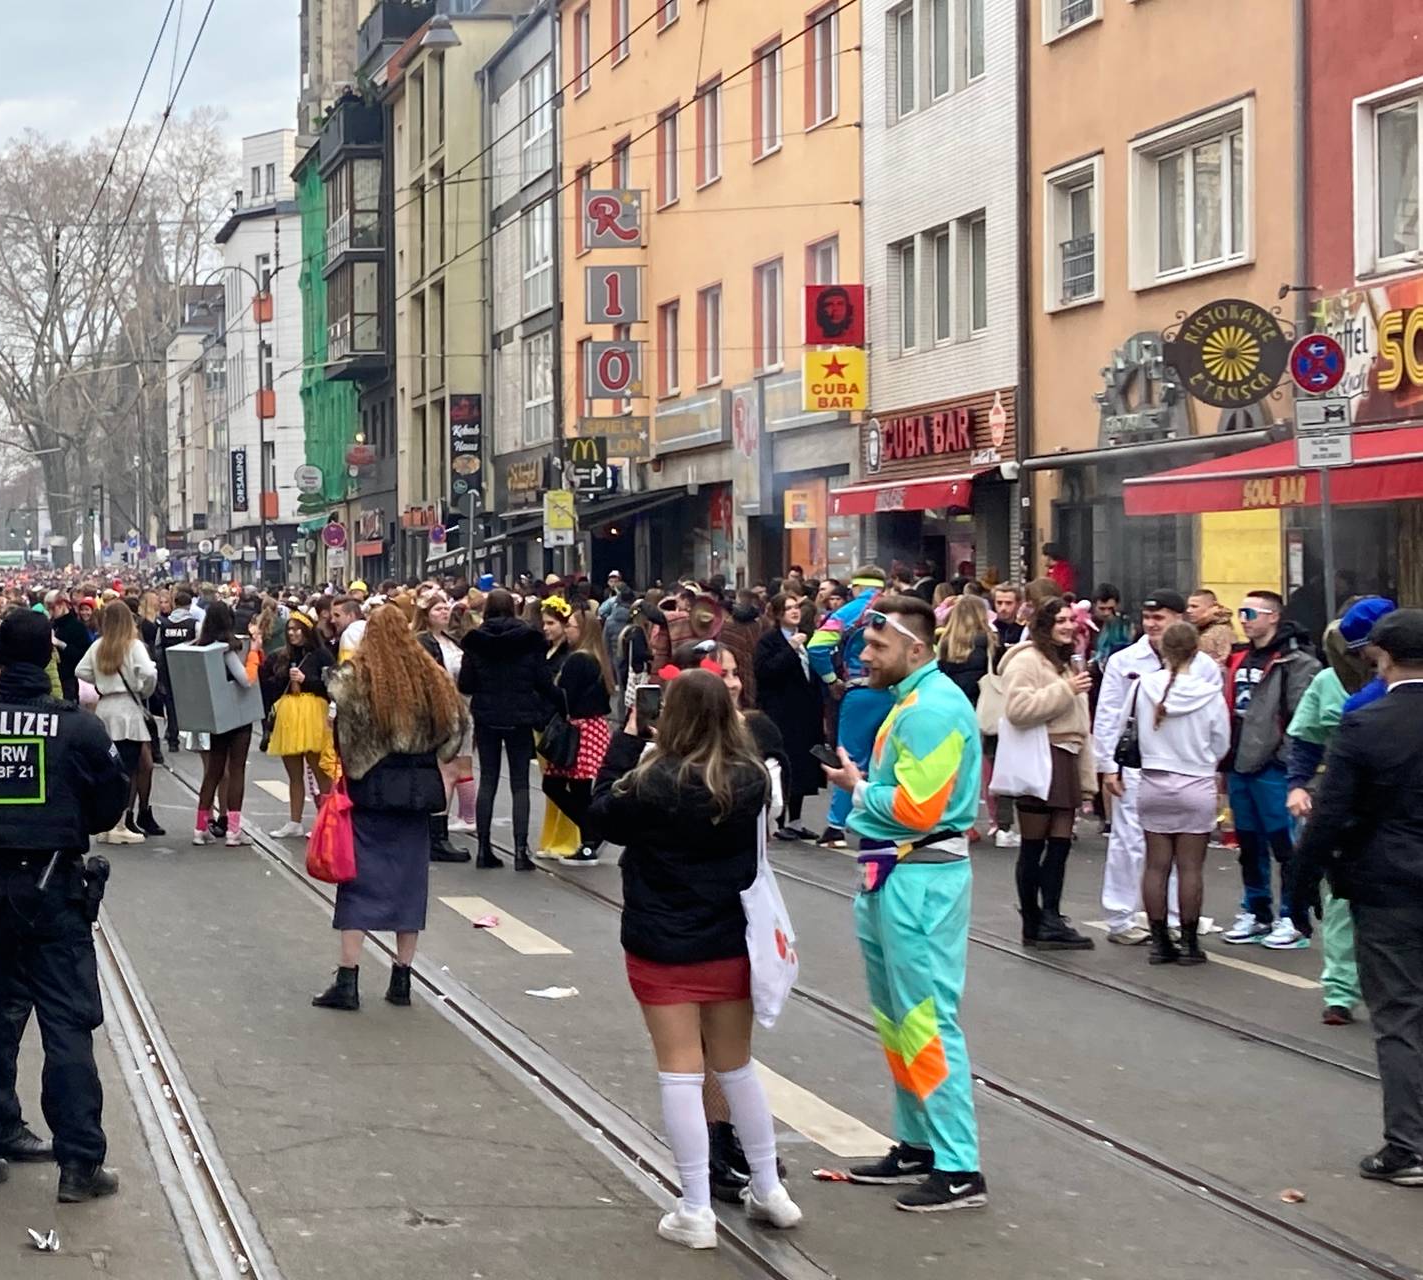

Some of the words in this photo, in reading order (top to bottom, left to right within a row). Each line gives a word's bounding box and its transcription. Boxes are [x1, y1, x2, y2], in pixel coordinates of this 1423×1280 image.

[1184, 304, 1277, 344] RISTORANTE
[811, 383, 860, 395] CUBA
[1189, 372, 1272, 401] ETRUSCA
[817, 397, 854, 408] BAR
[882, 414, 928, 460] CUBA
[933, 407, 970, 454] BAR
[608, 439, 642, 452] LON
[19, 766, 34, 778] 21
